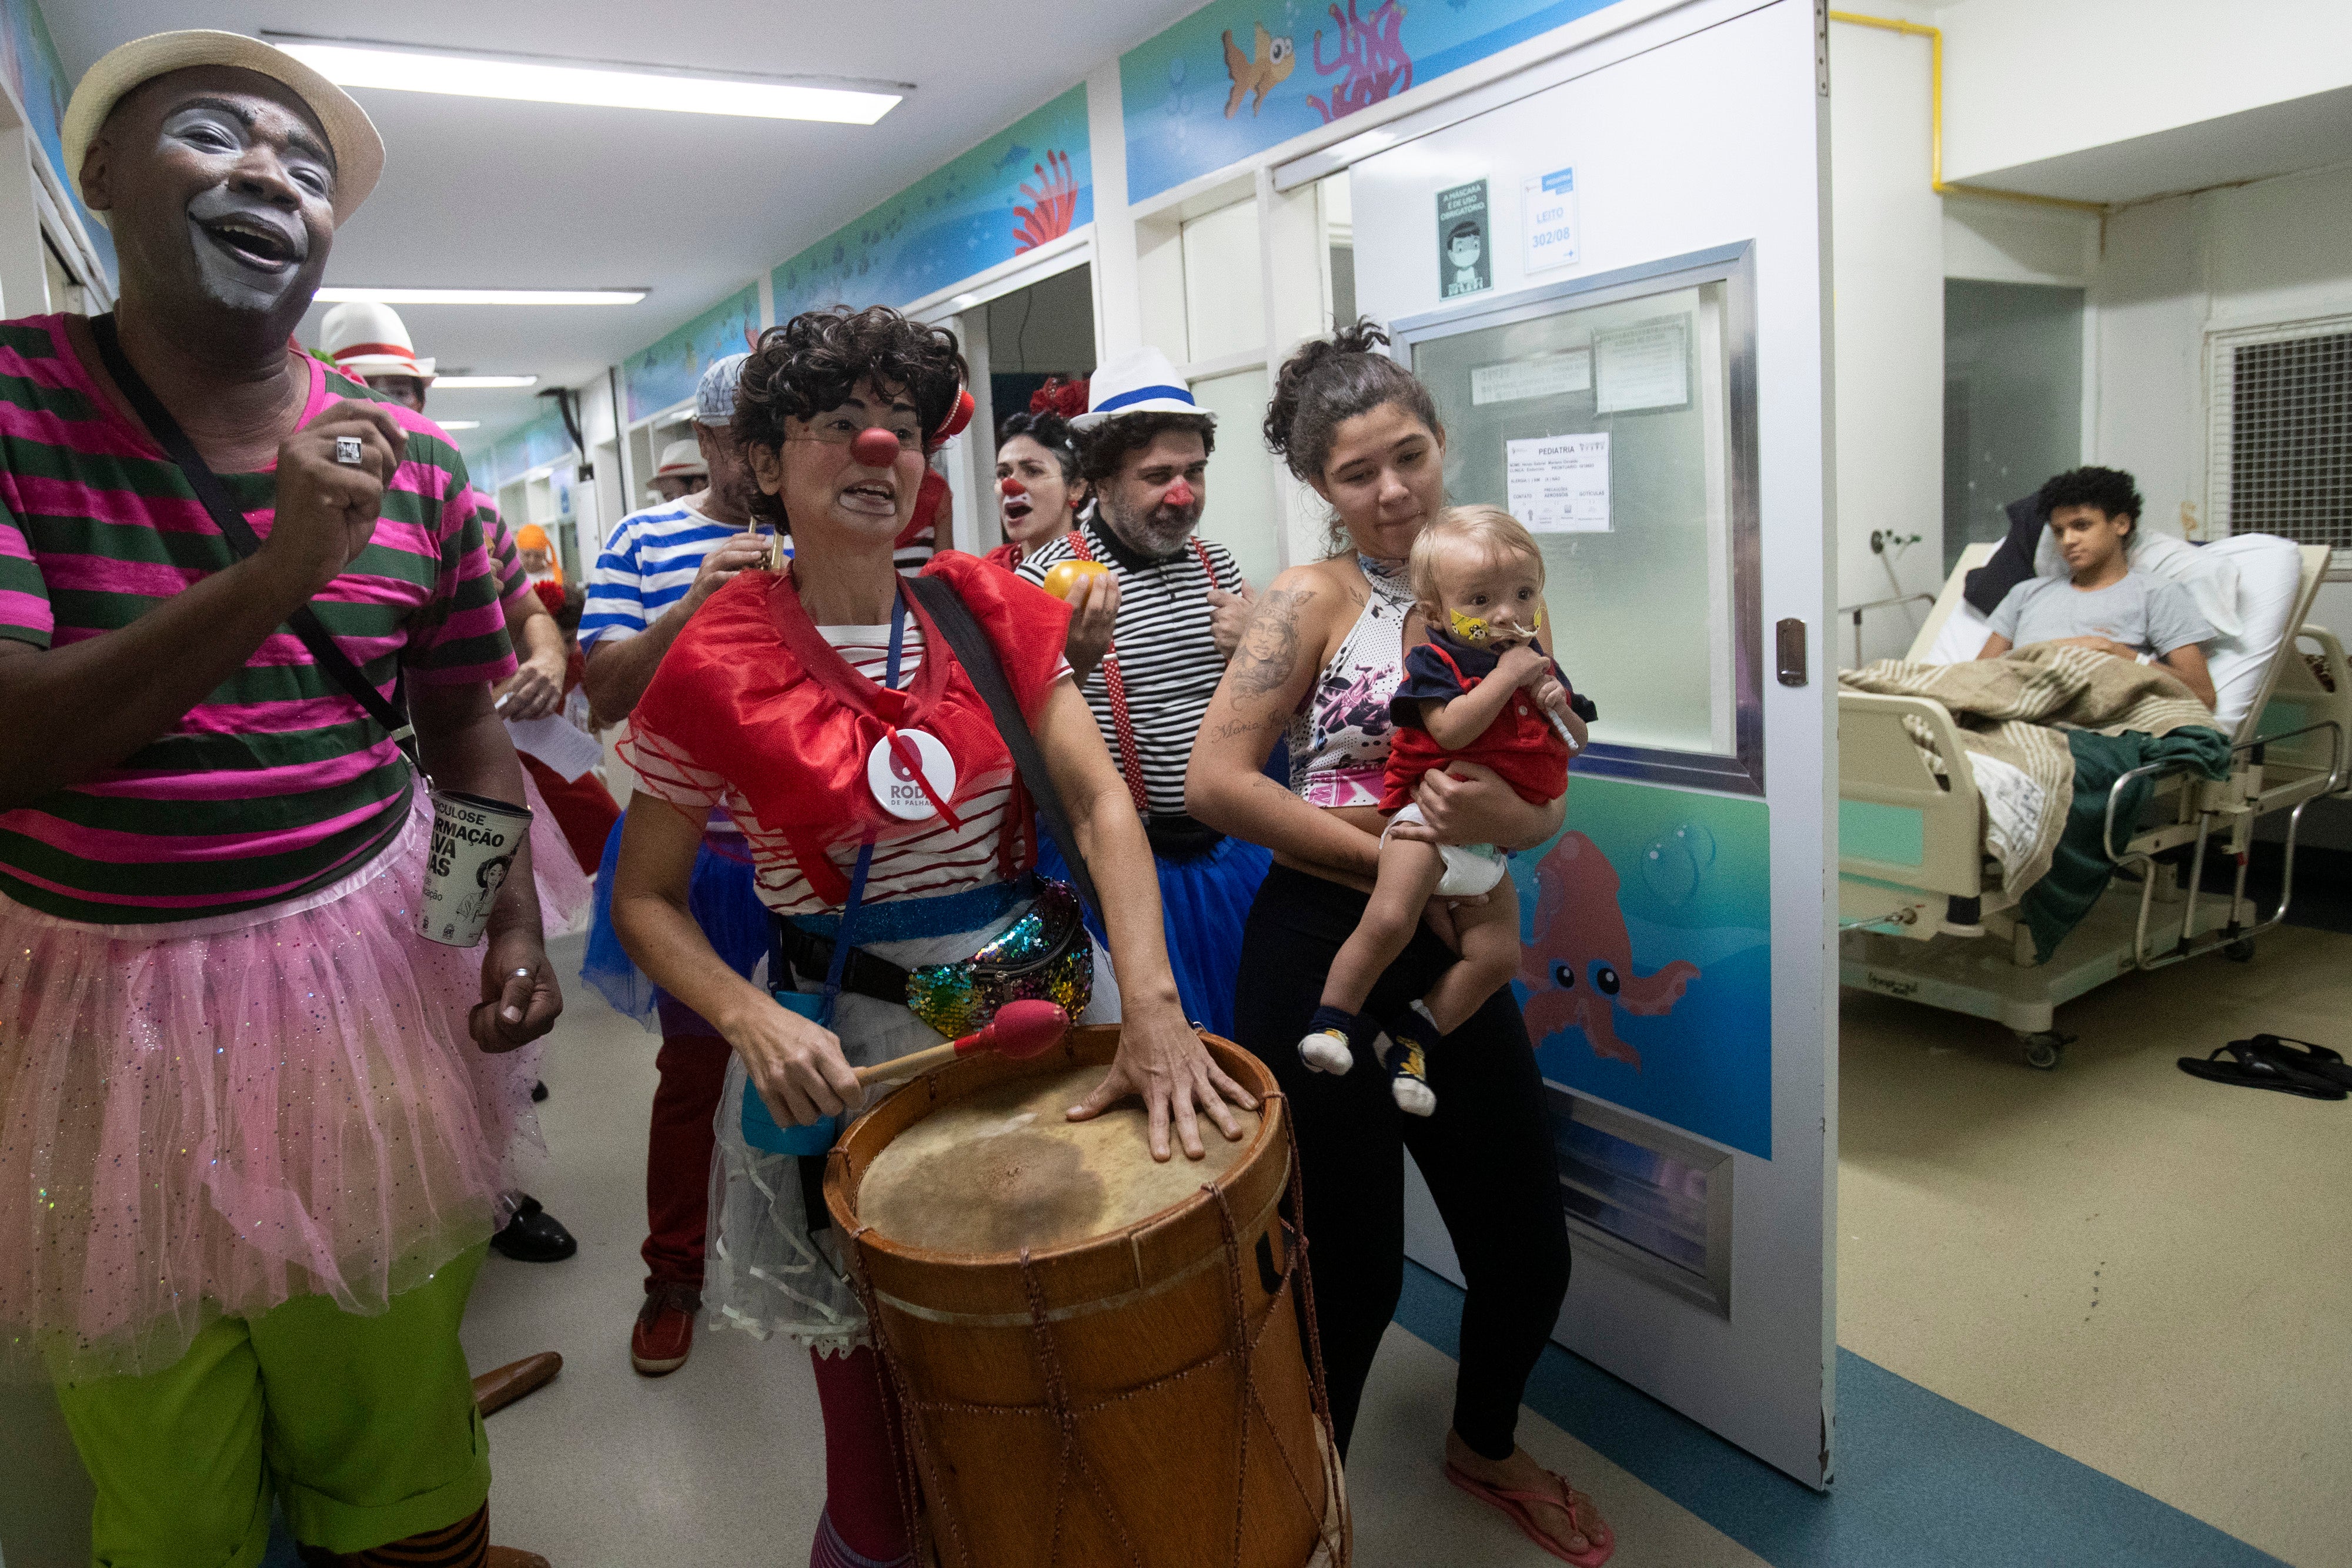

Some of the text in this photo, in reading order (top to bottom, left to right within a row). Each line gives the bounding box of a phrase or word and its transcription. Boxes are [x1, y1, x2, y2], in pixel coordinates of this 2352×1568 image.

[1536, 207, 1563, 225] LEITO
[1539, 446, 1575, 455] PEDIATRIA
[890, 785, 928, 799] ROD
[427, 854, 451, 877] AS
